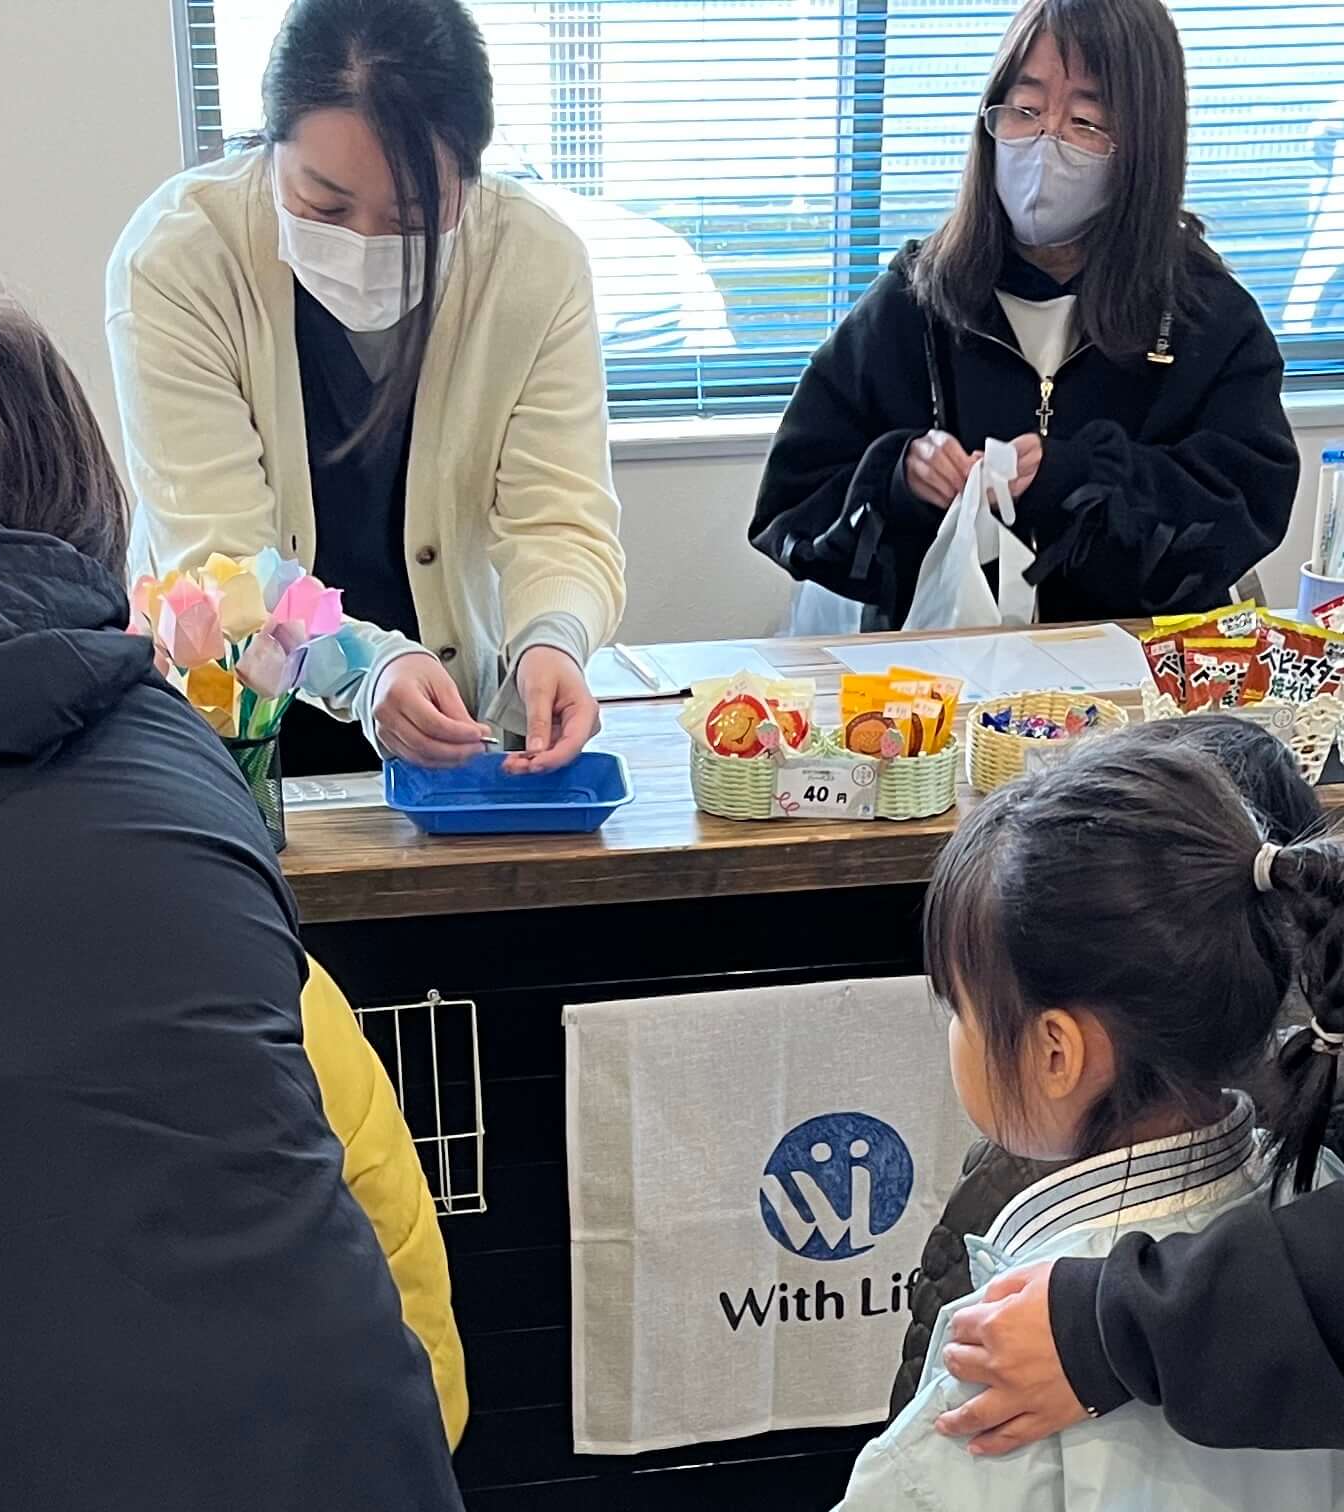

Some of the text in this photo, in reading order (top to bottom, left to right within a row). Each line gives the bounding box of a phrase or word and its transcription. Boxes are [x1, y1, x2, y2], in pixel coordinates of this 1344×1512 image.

[1259, 647, 1342, 685] ベビースター
[719, 1266, 921, 1331] With Lif
